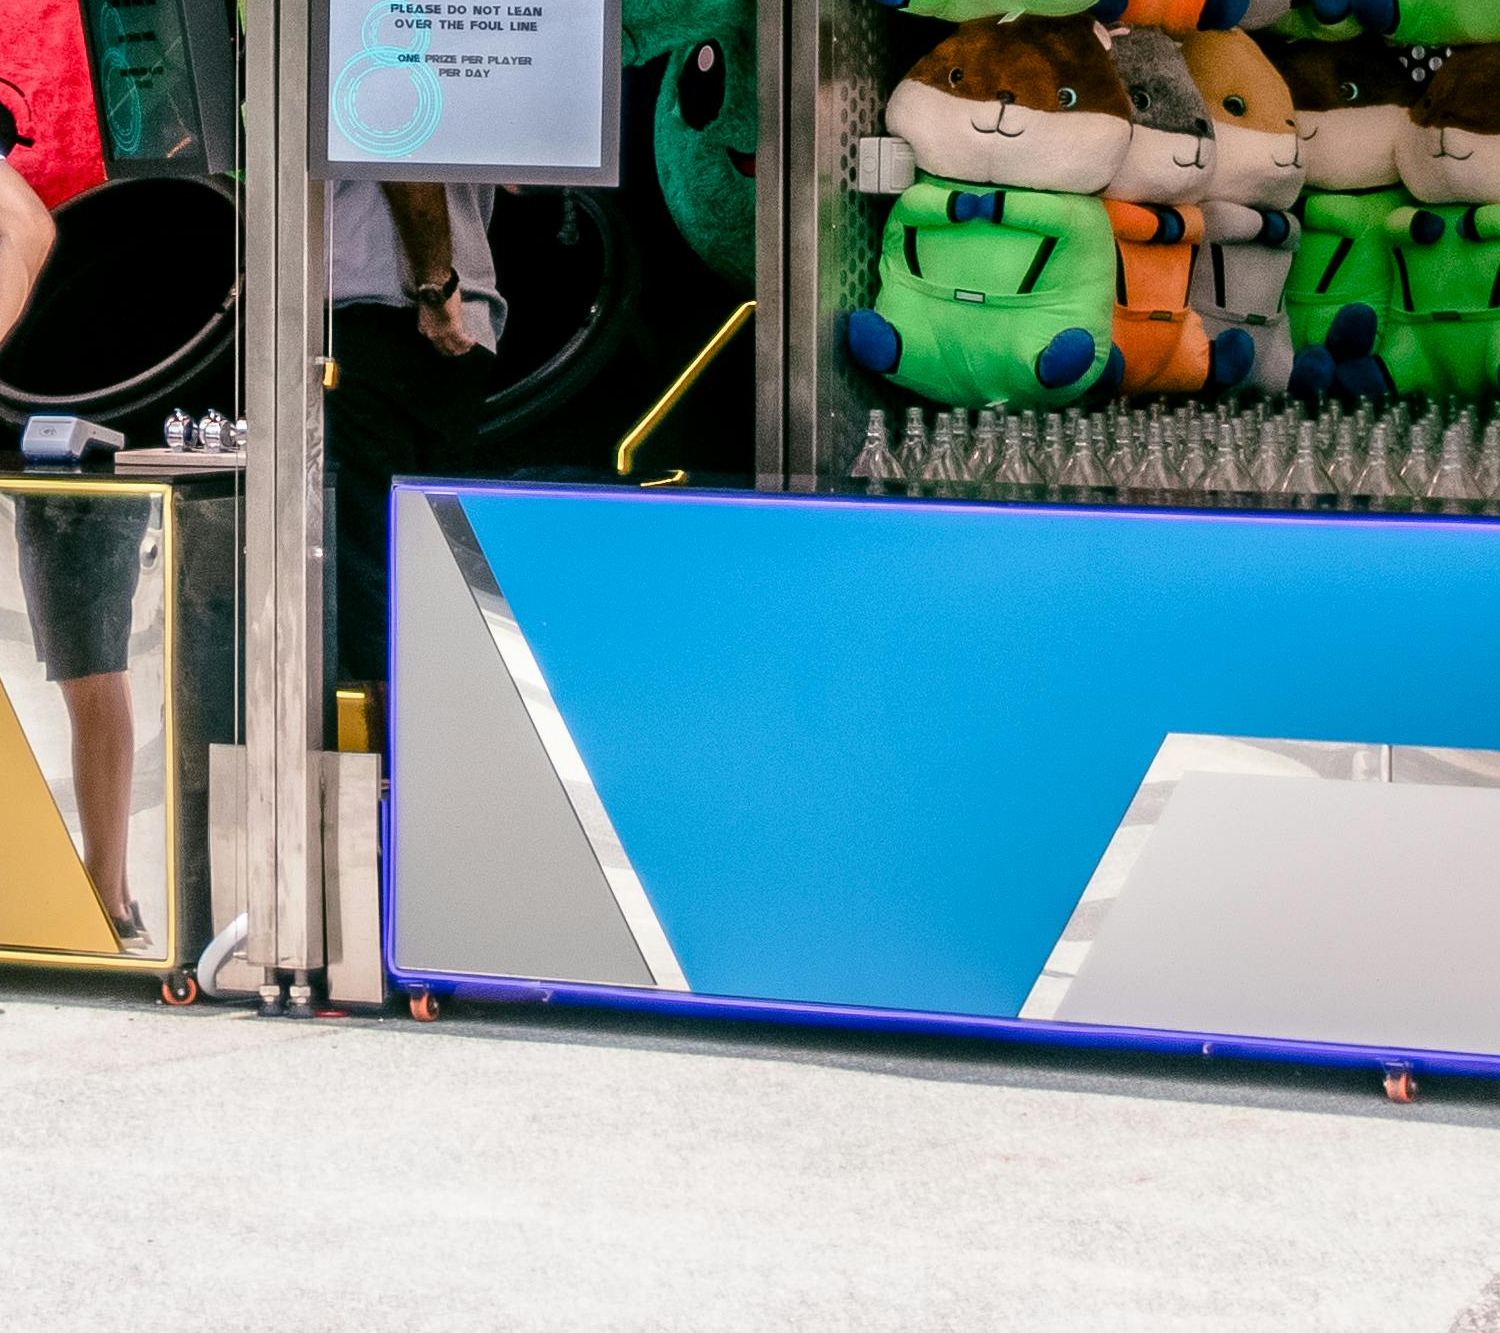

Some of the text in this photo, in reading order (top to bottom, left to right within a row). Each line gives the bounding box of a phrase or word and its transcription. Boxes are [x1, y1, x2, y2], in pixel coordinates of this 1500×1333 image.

[390, 3, 543, 17] PLEASE DO NOT LEAN
[394, 19, 538, 32] OVER THE FOUL LINE
[397, 54, 532, 66] ONE PRIZE PER PLAYER
[439, 68, 491, 78] PER DAY
